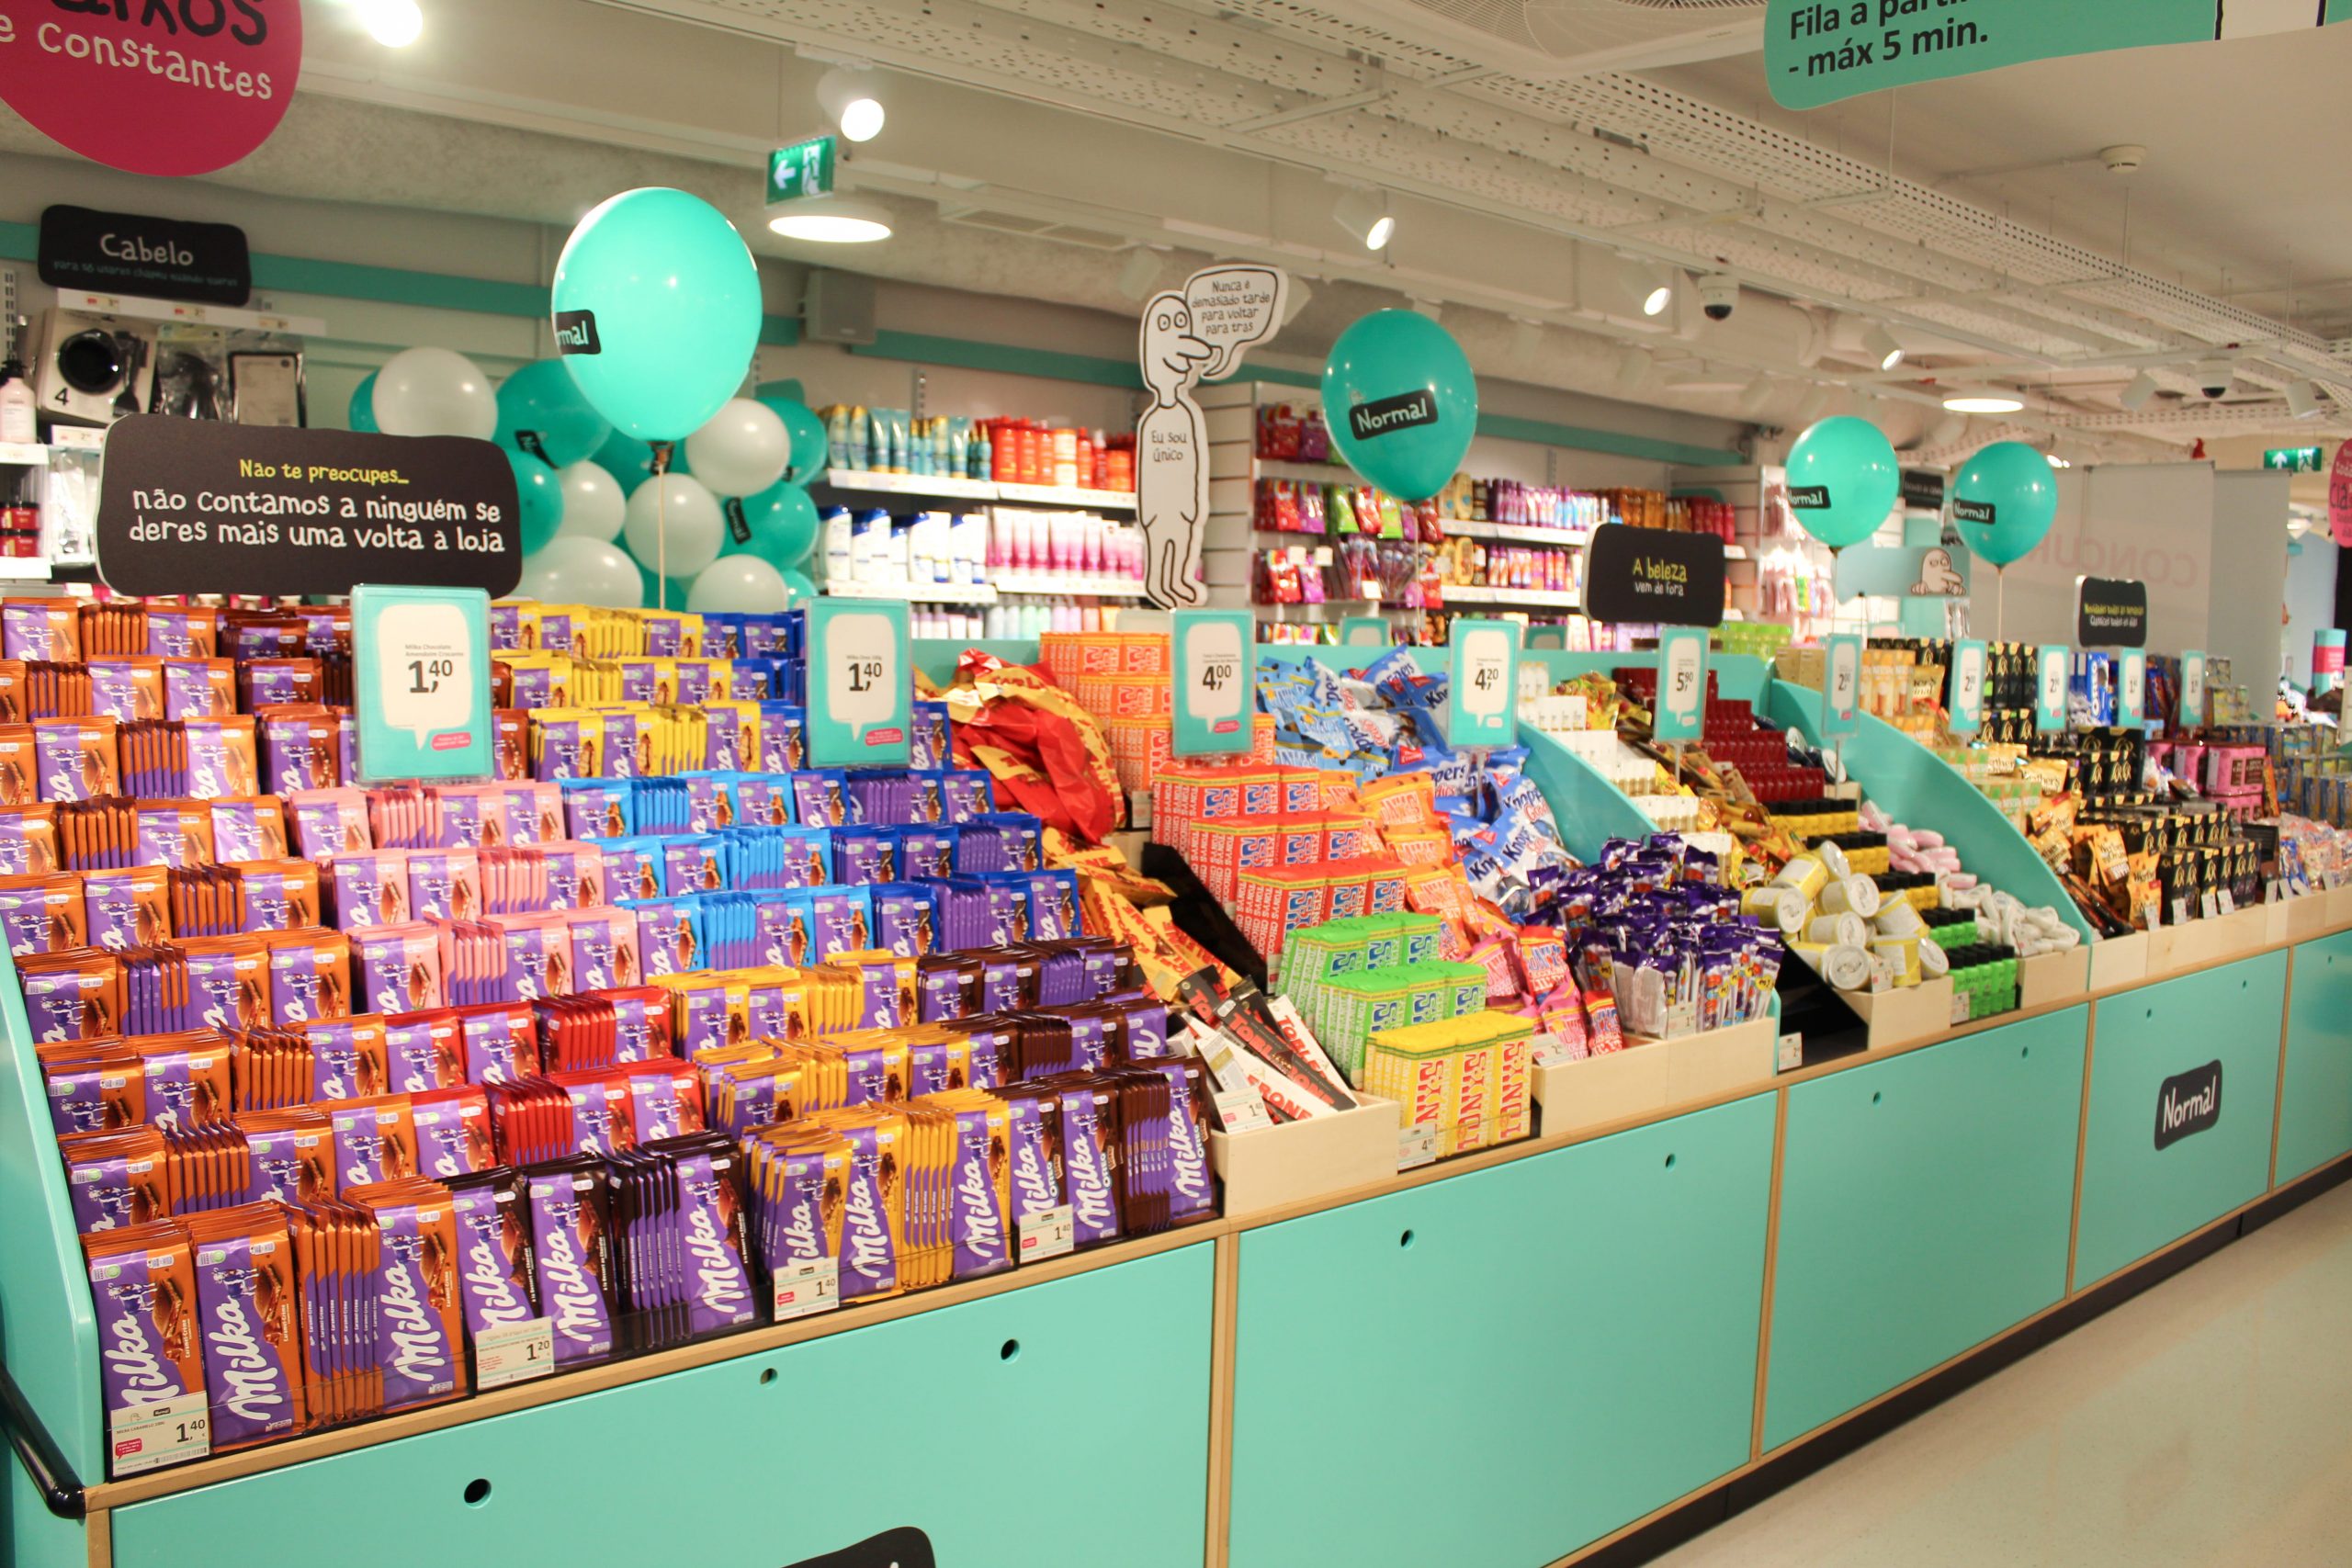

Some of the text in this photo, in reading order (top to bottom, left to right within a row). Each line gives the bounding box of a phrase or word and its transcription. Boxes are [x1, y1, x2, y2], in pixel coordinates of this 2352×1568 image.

[1791, 4, 1839, 39] Fila
[1850, 1, 1868, 26] a
[1808, 38, 1873, 76] máx
[1883, 29, 1902, 61] 5
[1912, 17, 1988, 55] min.
[100, 233, 194, 266] Cabelo
[1212, 280, 1242, 293] Nunca
[1242, 292, 1270, 304] tarde
[1202, 307, 1259, 323] para voltar
[1205, 323, 1228, 336] para
[55, 388, 70, 406] 4
[1356, 398, 1428, 433] Normal
[1151, 431, 1187, 444] Eu sou
[240, 458, 276, 479] Não
[282, 463, 301, 479] te
[133, 489, 187, 512] não
[340, 497, 358, 518] a
[367, 496, 467, 523] ninguém
[476, 500, 501, 523] se
[1954, 504, 1990, 521] Normal
[130, 515, 208, 542] deres
[219, 520, 279, 546] mais
[288, 525, 346, 548] uma
[355, 525, 424, 550] volta
[457, 527, 505, 552] loja
[1633, 556, 1688, 582] A beleza
[2163, 1075, 2216, 1133] Normal
[1169, 1106, 1205, 1199] Milka
[1069, 1134, 1111, 1229] Milka
[958, 1156, 1001, 1258] Milka
[783, 1200, 826, 1267] ilka
[844, 1175, 890, 1279] Milka
[684, 1204, 745, 1314] Milka
[540, 1225, 602, 1342] Milka
[380, 1259, 446, 1382] Milka
[209, 1295, 283, 1421] Milka
